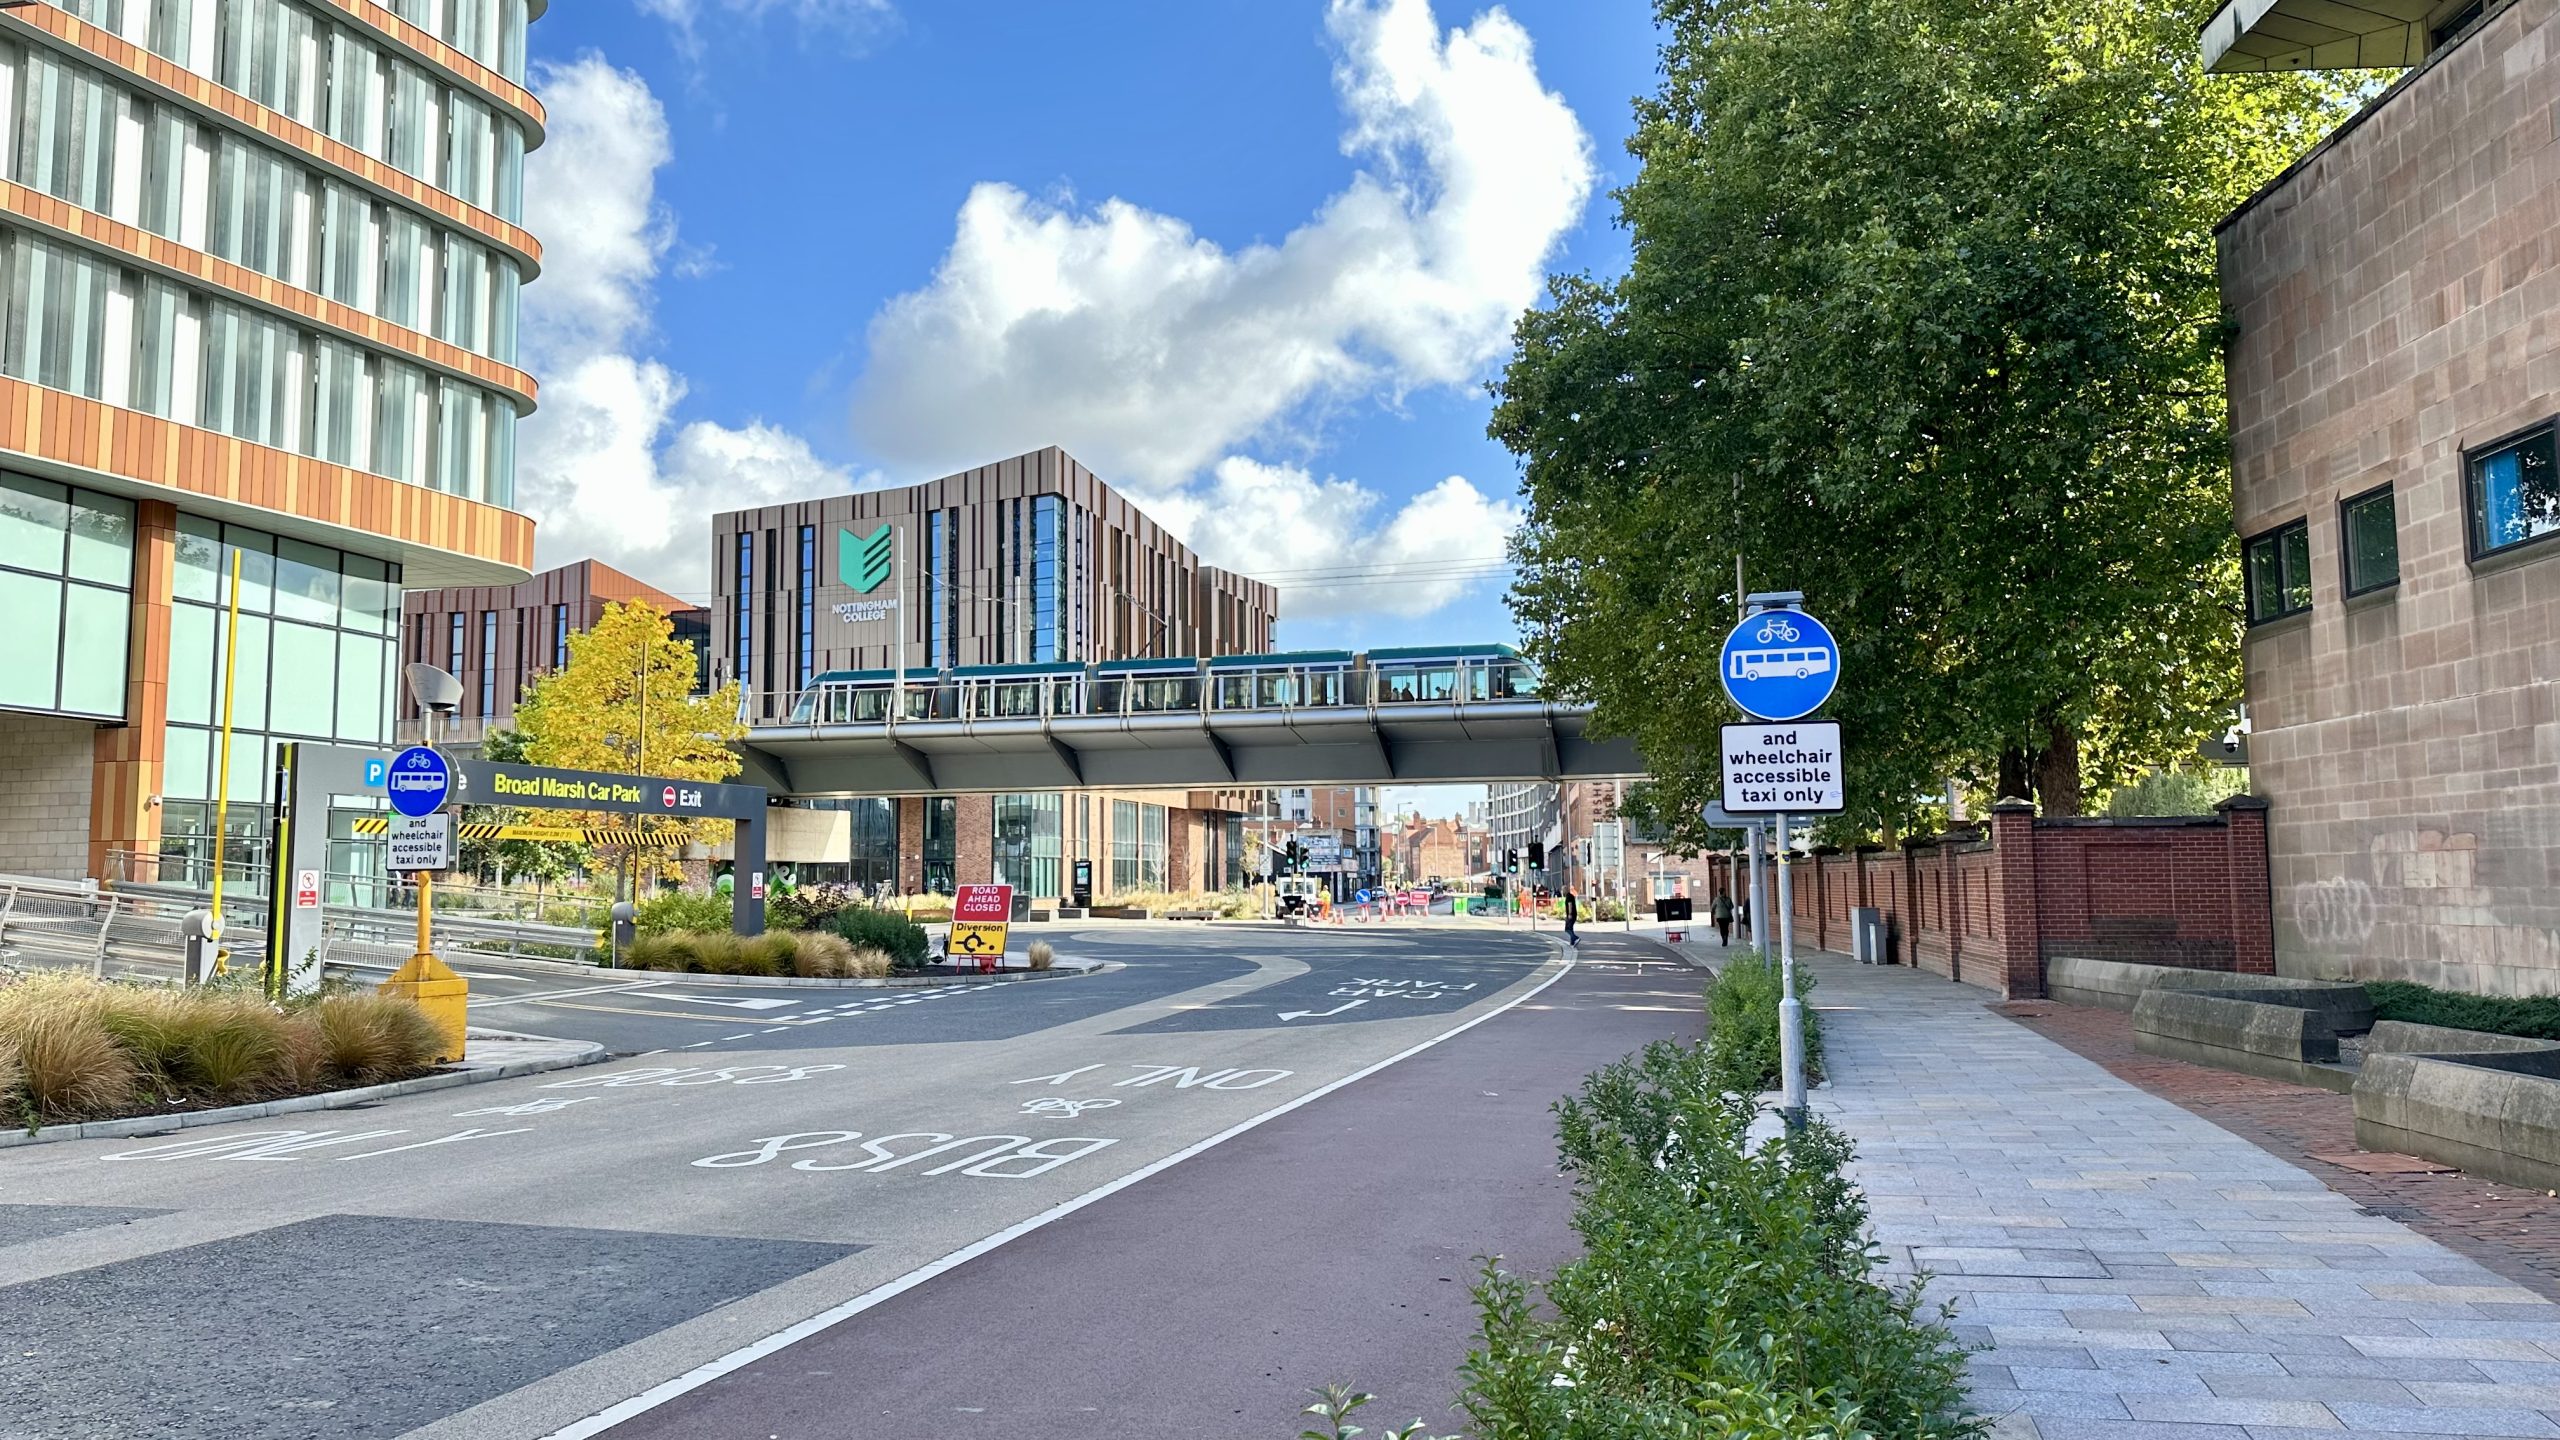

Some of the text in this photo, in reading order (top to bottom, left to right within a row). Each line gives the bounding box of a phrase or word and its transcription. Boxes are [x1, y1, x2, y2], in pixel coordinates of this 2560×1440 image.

[832, 599, 897, 614] NOTTINGHAM
[843, 610, 886, 623] COLLEGE
[1763, 730, 1797, 745] and
[1729, 749, 1832, 765] wheelchair
[369, 764, 382, 782] P
[1733, 768, 1831, 784] accessible
[494, 773, 641, 803] Broad Marsh Car Park
[679, 789, 703, 808] Exit
[1741, 787, 1824, 804] taxi only
[409, 819, 427, 828] and
[392, 831, 443, 840] wheelchair
[392, 844, 442, 853] accessible
[396, 855, 437, 865] taxi only
[972, 886, 998, 895] ROAD
[967, 895, 1000, 903] AHEAD
[963, 903, 1002, 912] CLOSED
[956, 923, 1003, 932] Diversion
[1338, 978, 1478, 990] PARK
[1328, 987, 1442, 999] CAR
[1009, 1064, 1294, 1090] ONLY
